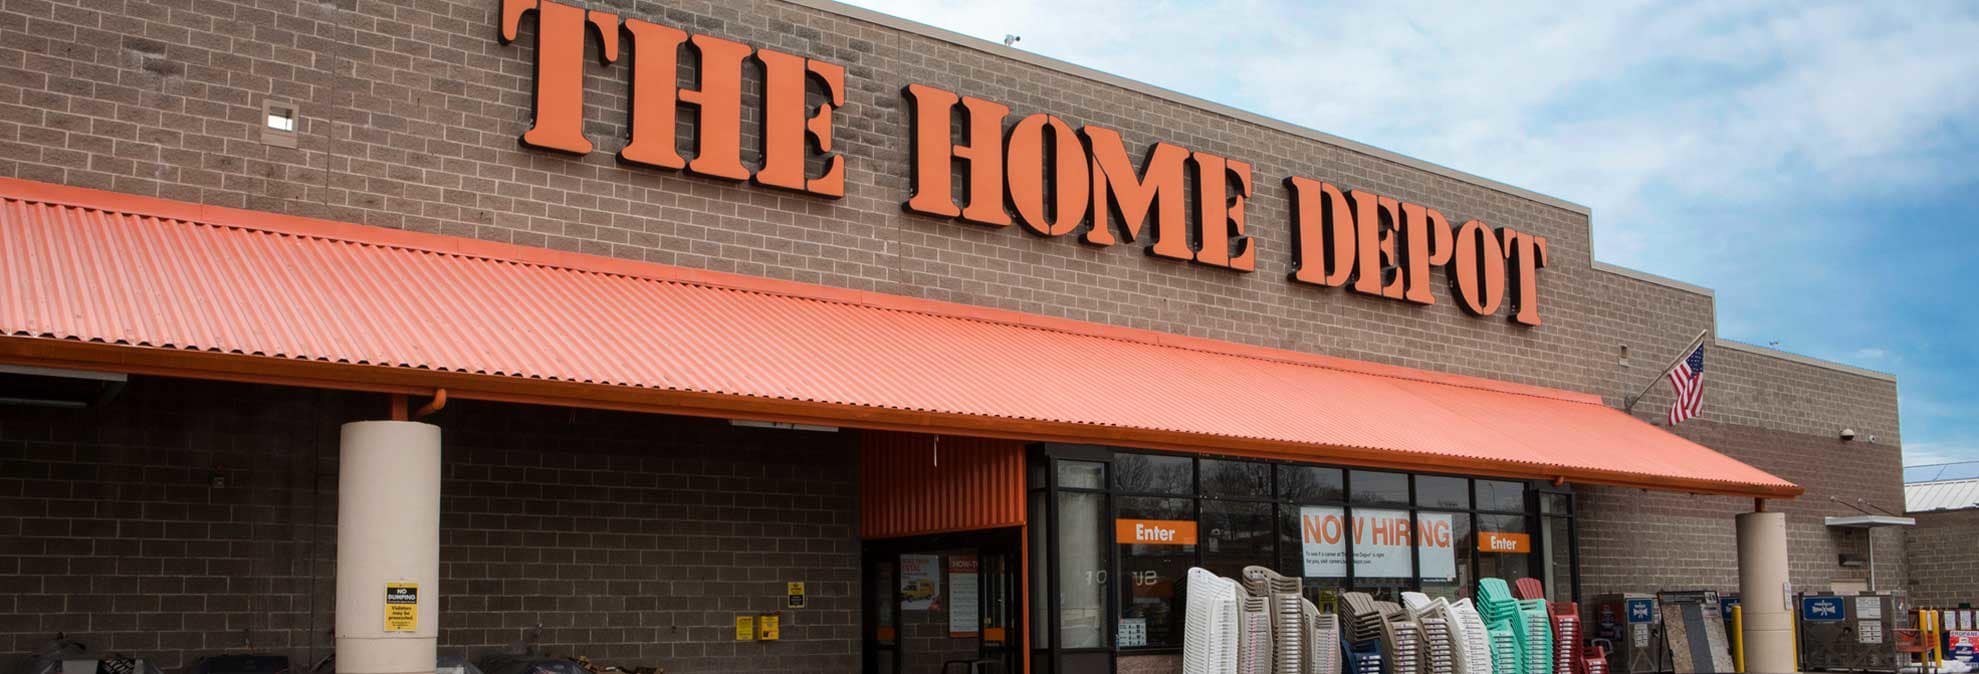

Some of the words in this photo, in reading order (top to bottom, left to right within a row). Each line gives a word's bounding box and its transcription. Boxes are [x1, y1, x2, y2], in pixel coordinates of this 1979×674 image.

[500, 0, 845, 199] THE
[904, 83, 1255, 272] HOME
[1285, 176, 1547, 327] DEPOT
[1136, 523, 1175, 541] Enter
[1303, 514, 1364, 545] NOW
[1371, 517, 1450, 548] HIRNG
[1491, 535, 1517, 550] Enter
